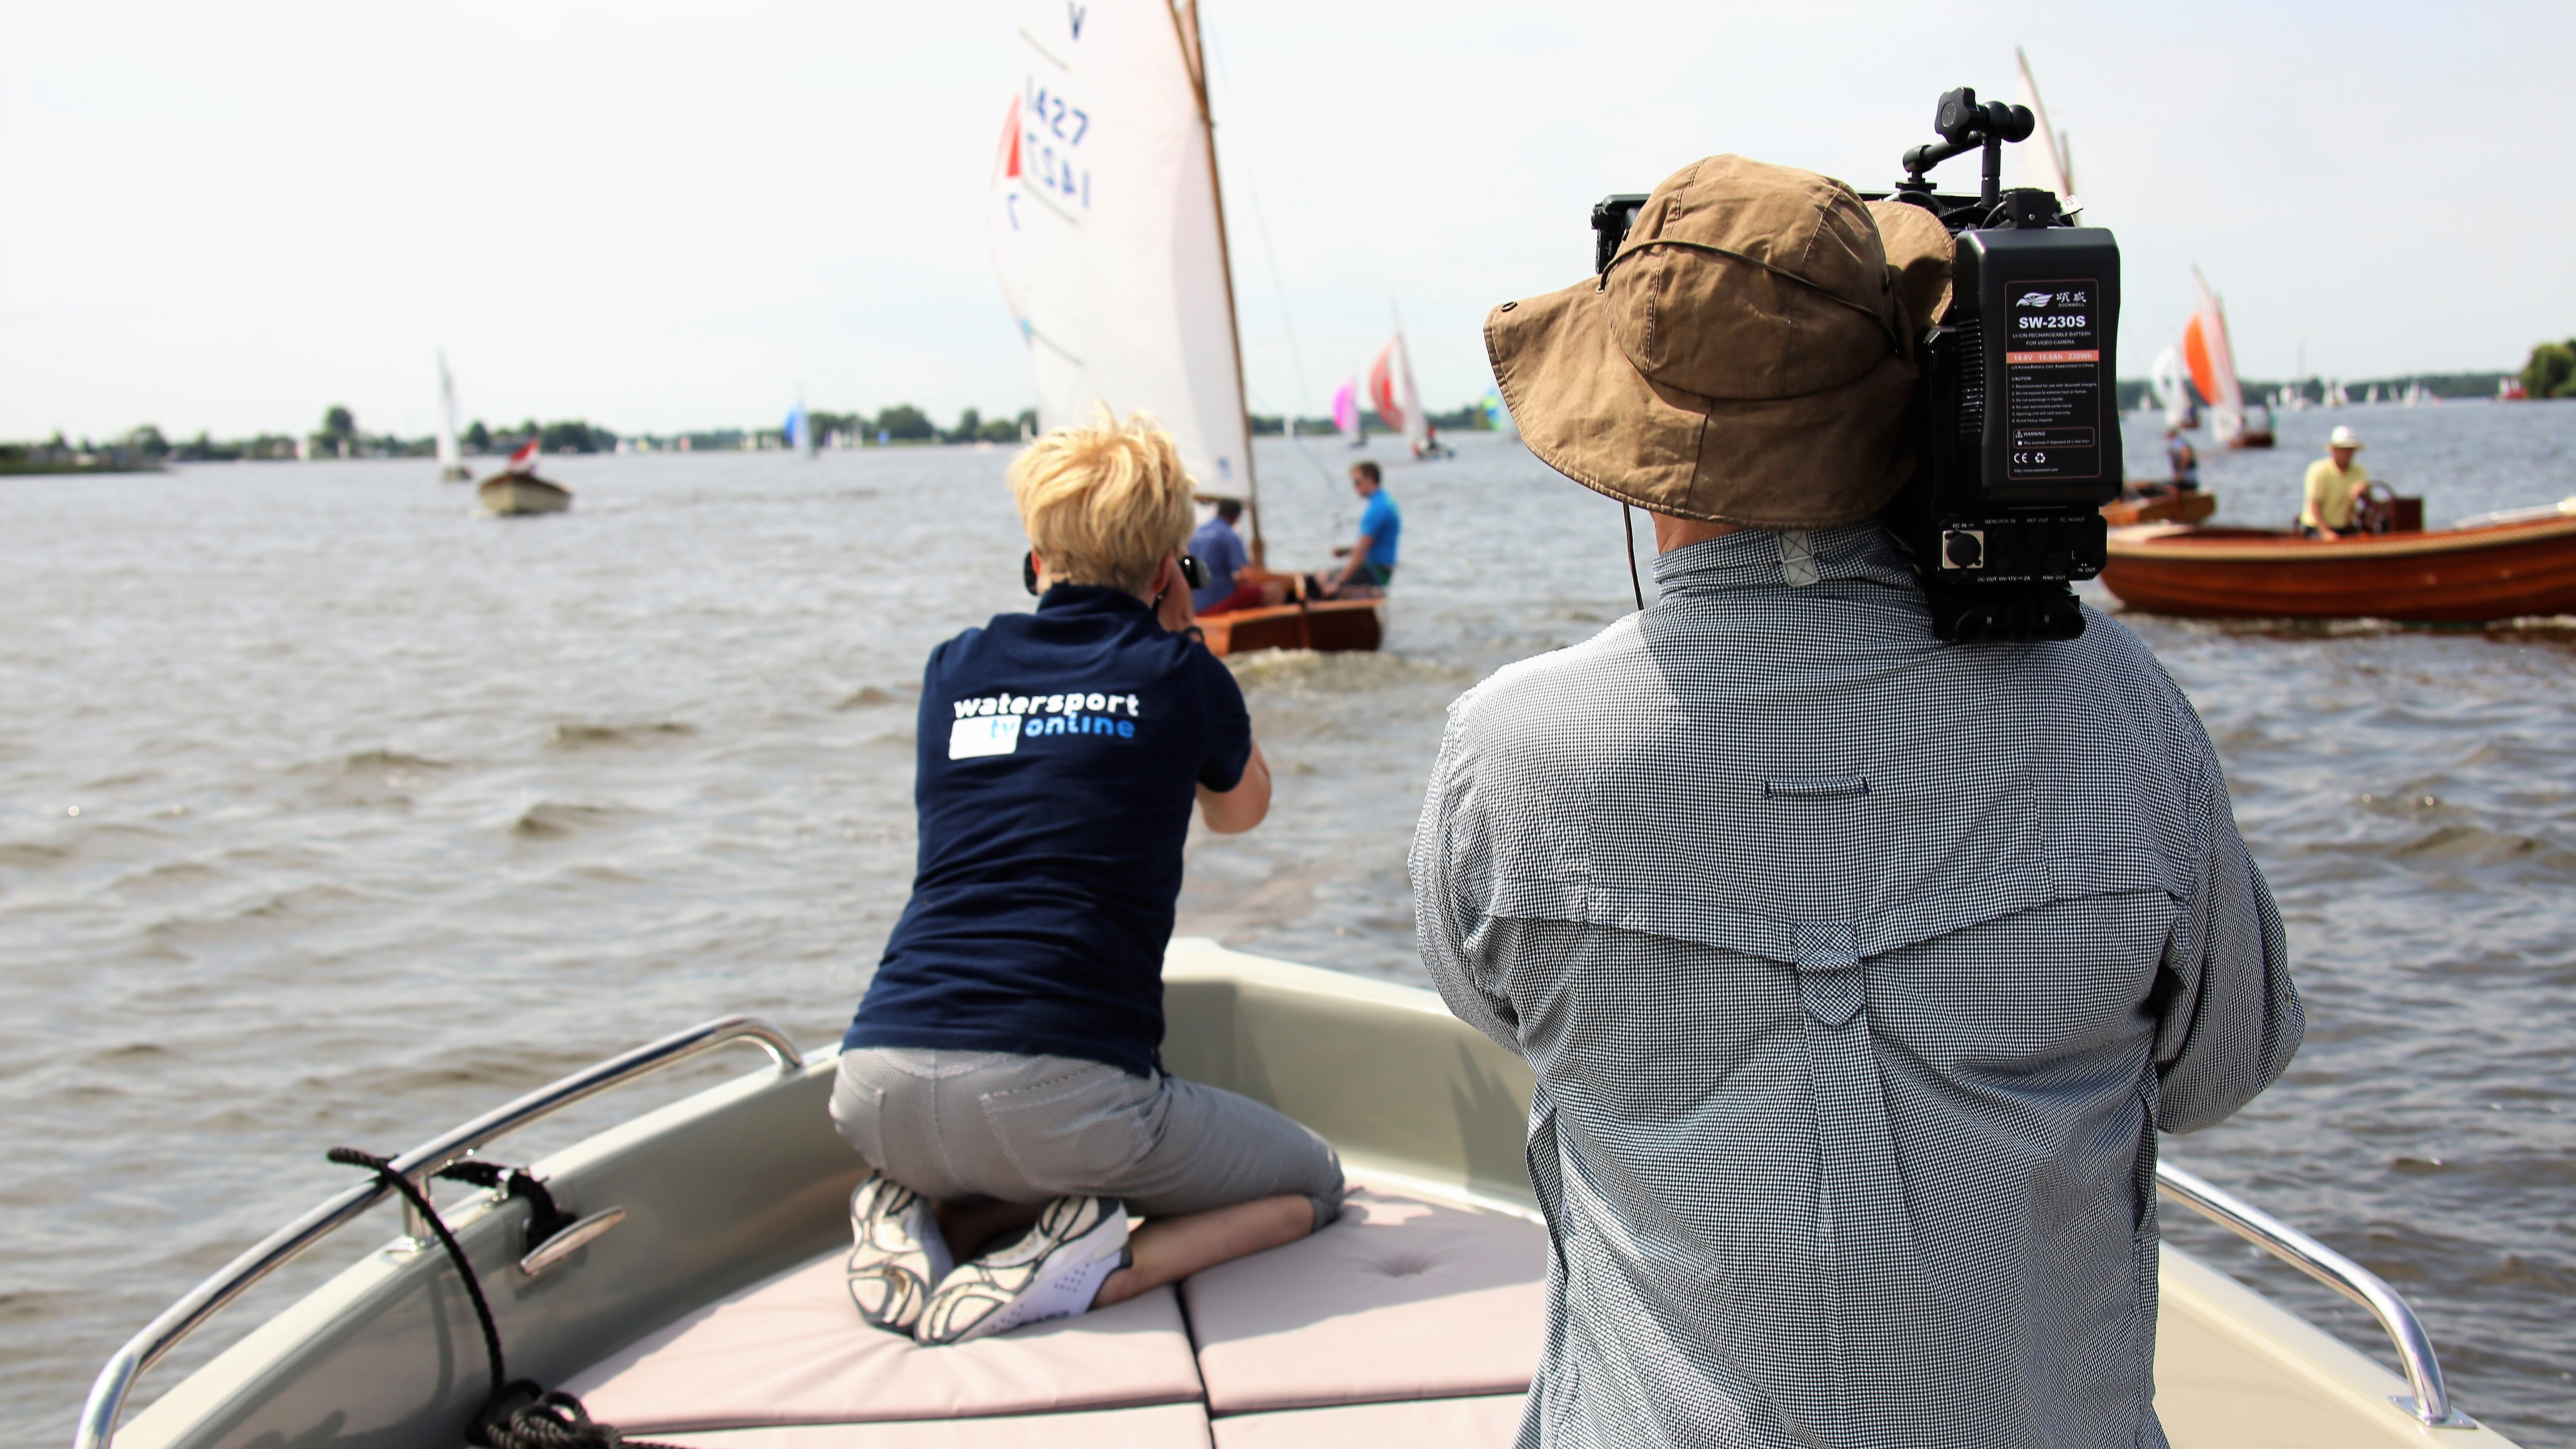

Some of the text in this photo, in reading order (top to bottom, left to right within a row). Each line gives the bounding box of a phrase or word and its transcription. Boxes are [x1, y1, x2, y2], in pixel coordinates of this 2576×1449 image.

[1025, 74, 1089, 146] 1427
[2019, 315, 2086, 329] SW-230S
[2014, 453, 2027, 463] CE
[953, 692, 1140, 719] watersport
[1025, 711, 1135, 738] online
